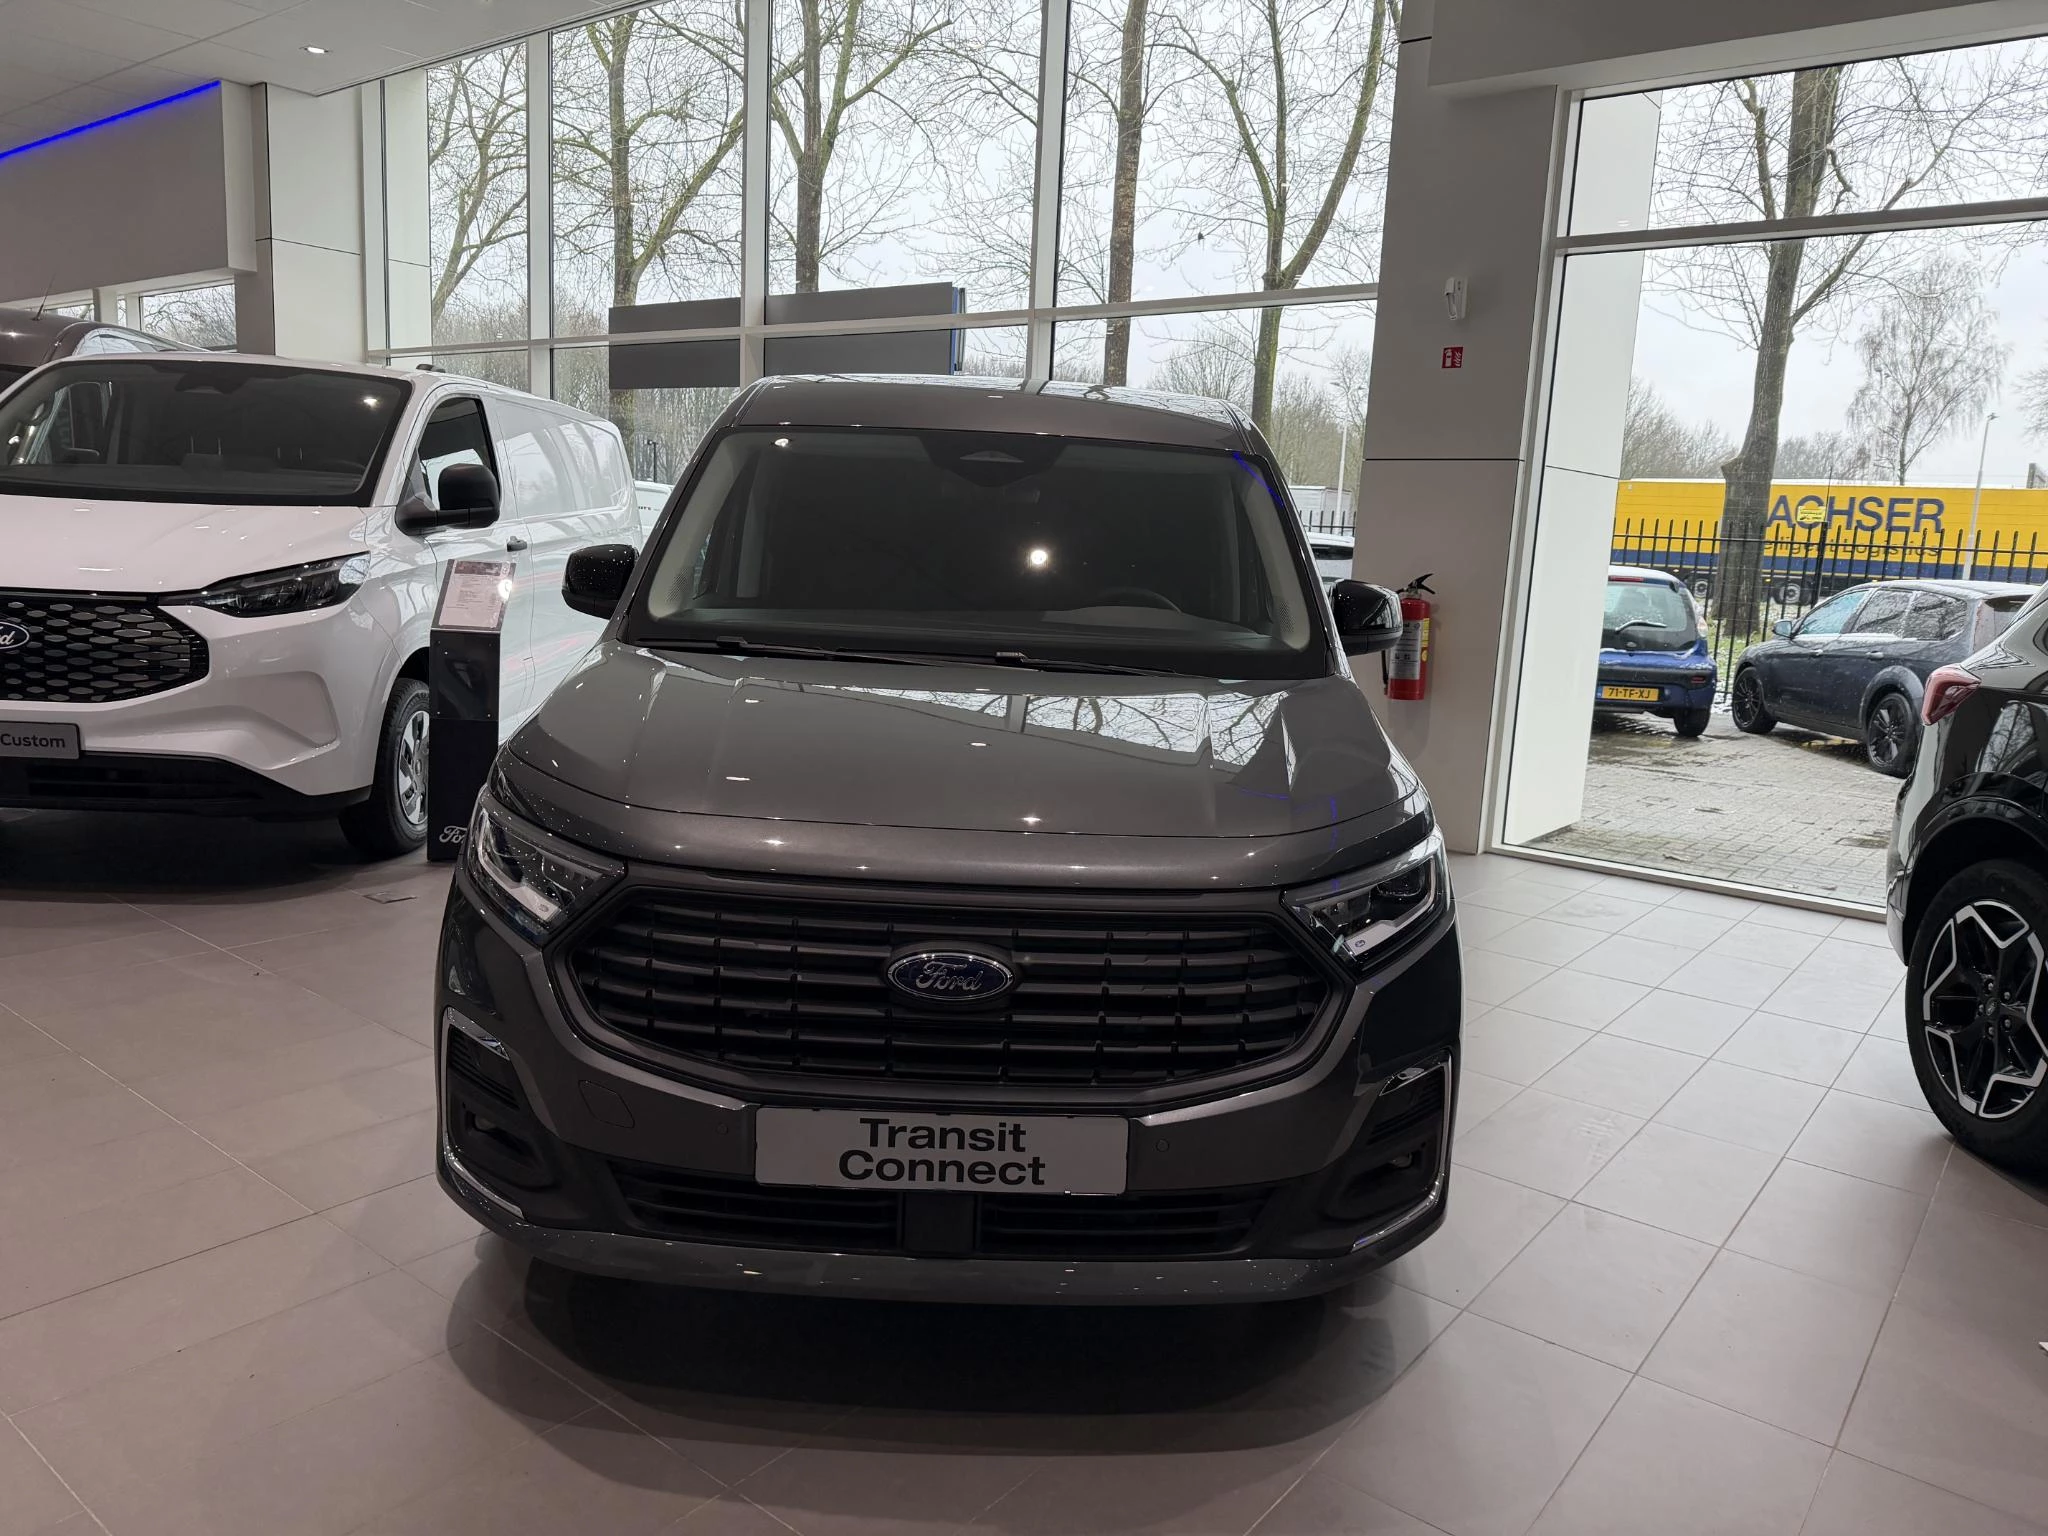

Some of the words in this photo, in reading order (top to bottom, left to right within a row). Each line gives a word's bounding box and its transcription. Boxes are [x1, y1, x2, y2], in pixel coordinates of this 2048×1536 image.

[1766, 495, 1945, 533] ACHSER
[1608, 687, 1651, 699] 71-TF-XJ
[1, 733, 66, 748] Custom
[439, 825, 467, 844] Fo
[915, 961, 984, 991] Ford
[859, 1117, 1027, 1153] Transit
[838, 1149, 1046, 1186] Connect
